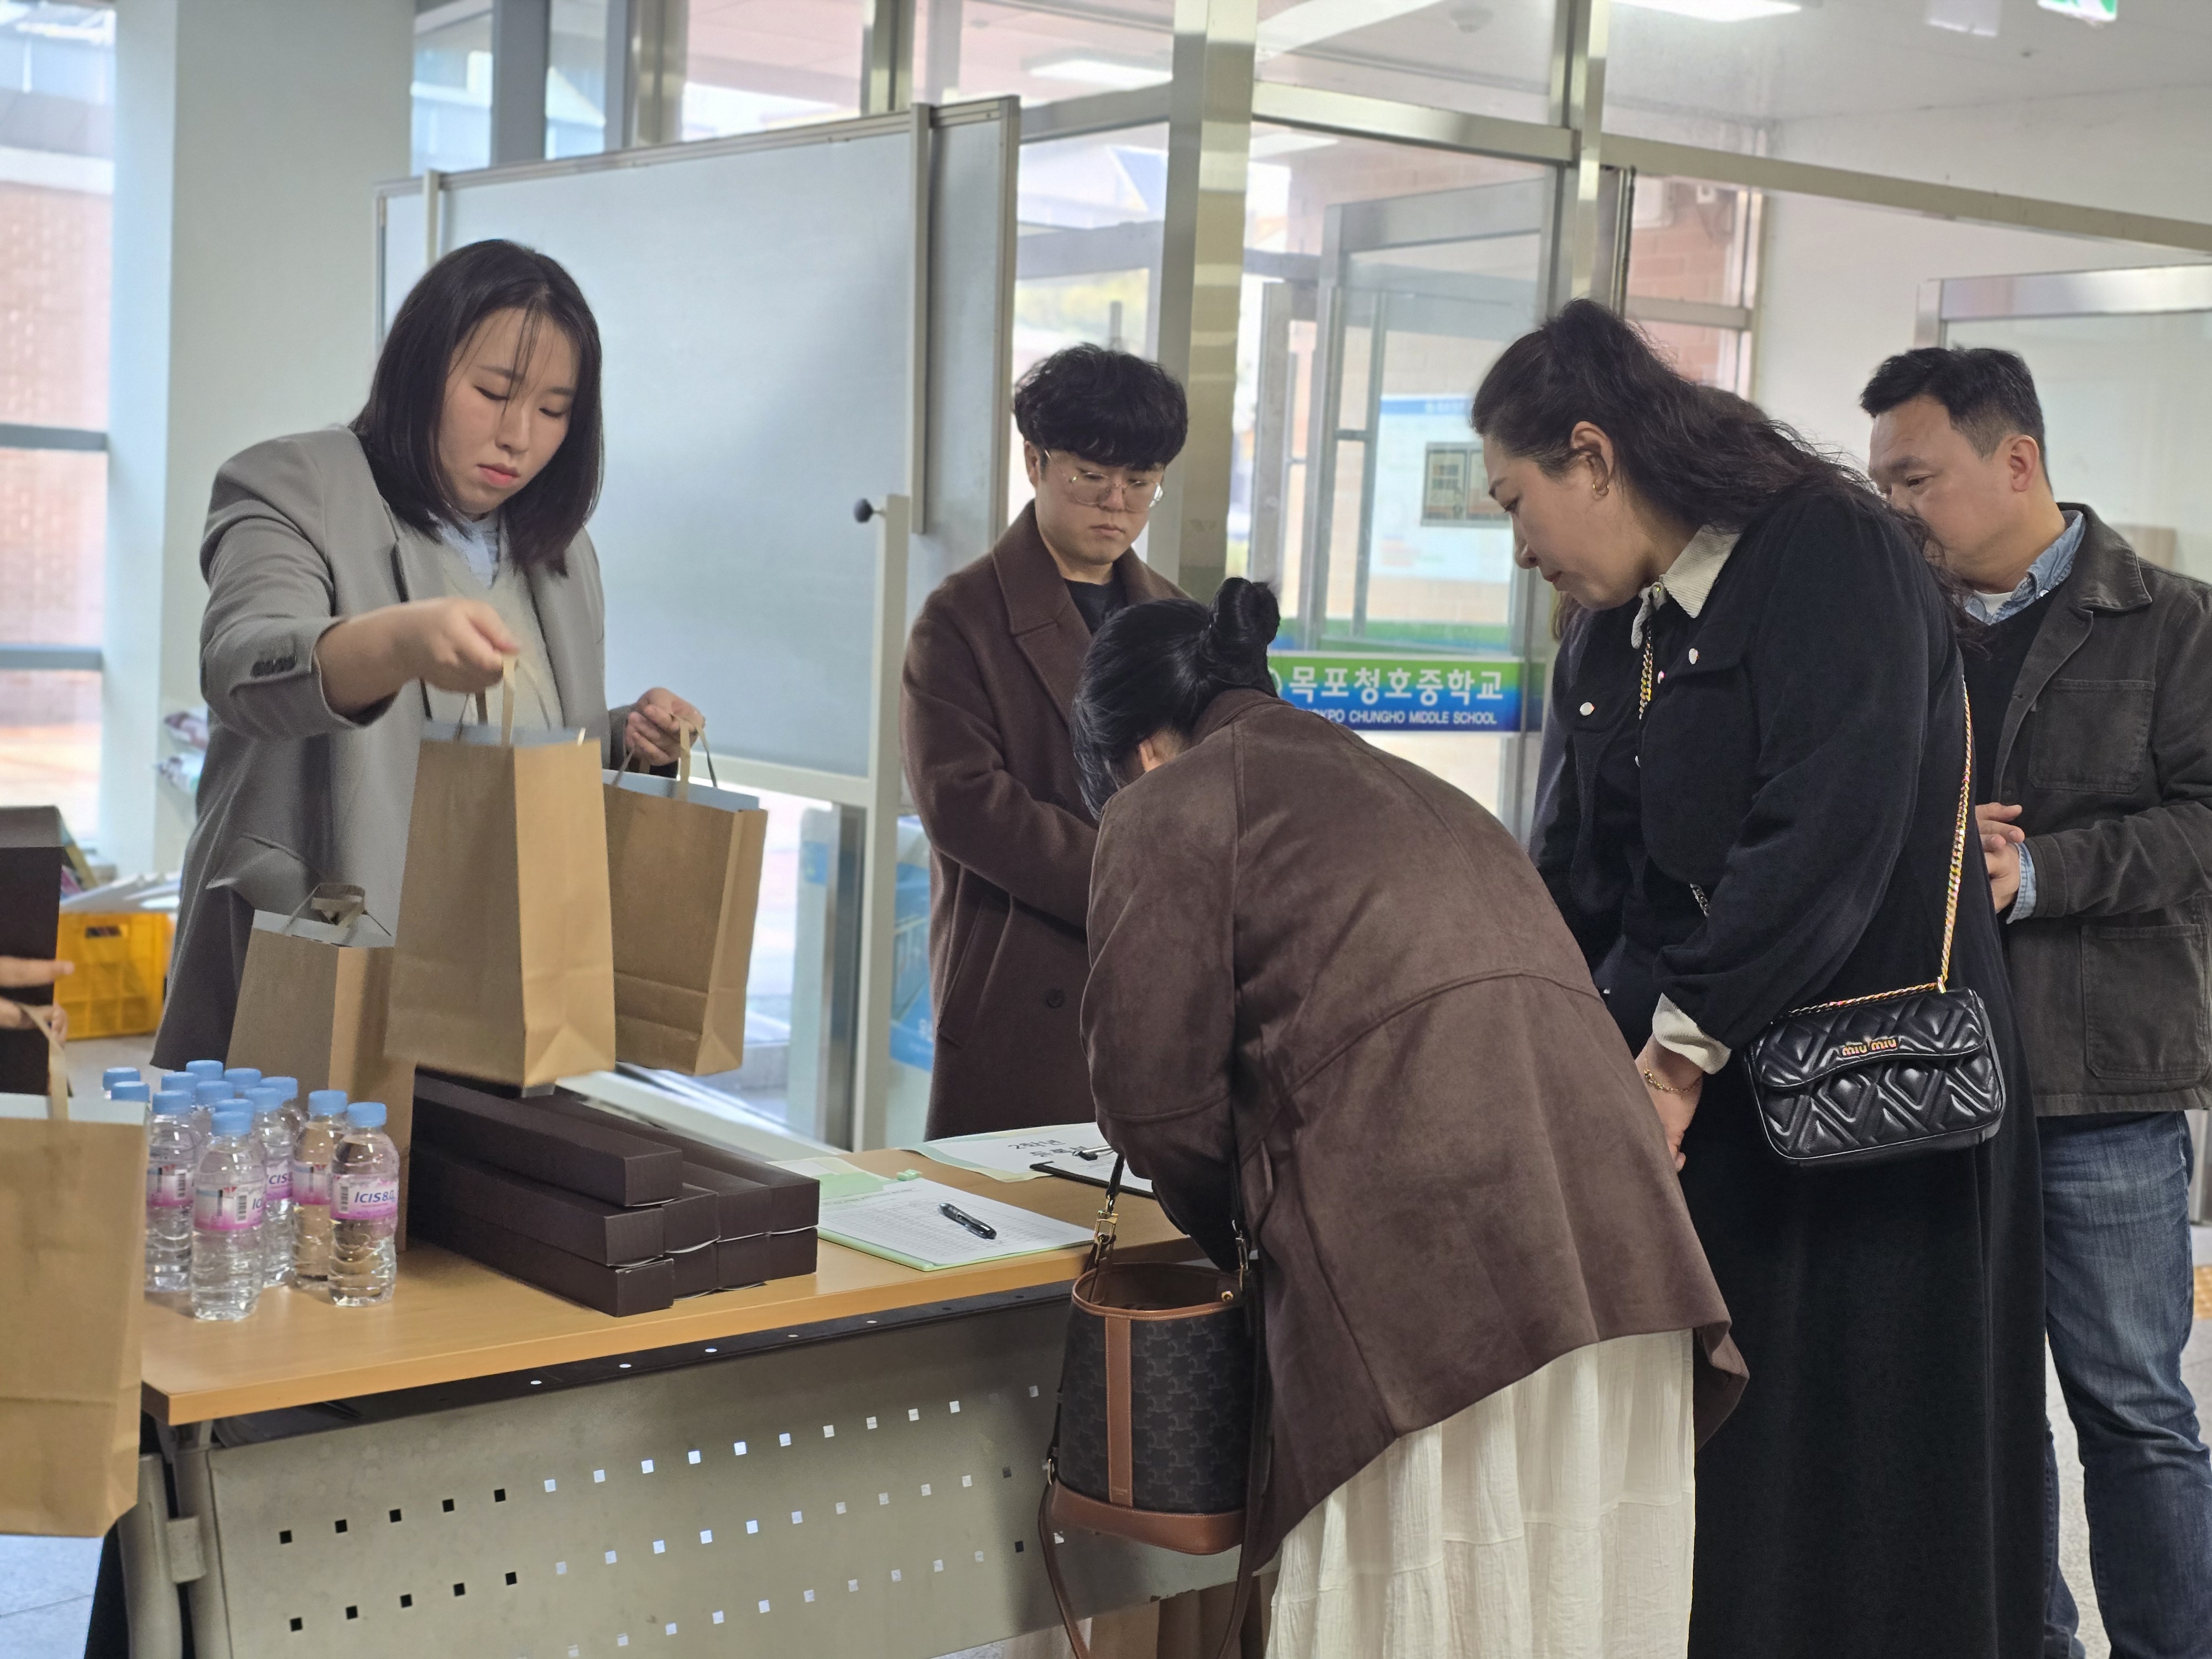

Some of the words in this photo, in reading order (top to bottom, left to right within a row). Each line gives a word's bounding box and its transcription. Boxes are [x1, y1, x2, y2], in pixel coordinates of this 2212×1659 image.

[1289, 666, 1503, 706] 목포청호중학교
[1349, 710, 1405, 723] CHUNGHO
[1409, 711, 1449, 724] MIDDLE
[1453, 711, 1497, 724] SCHOOL
